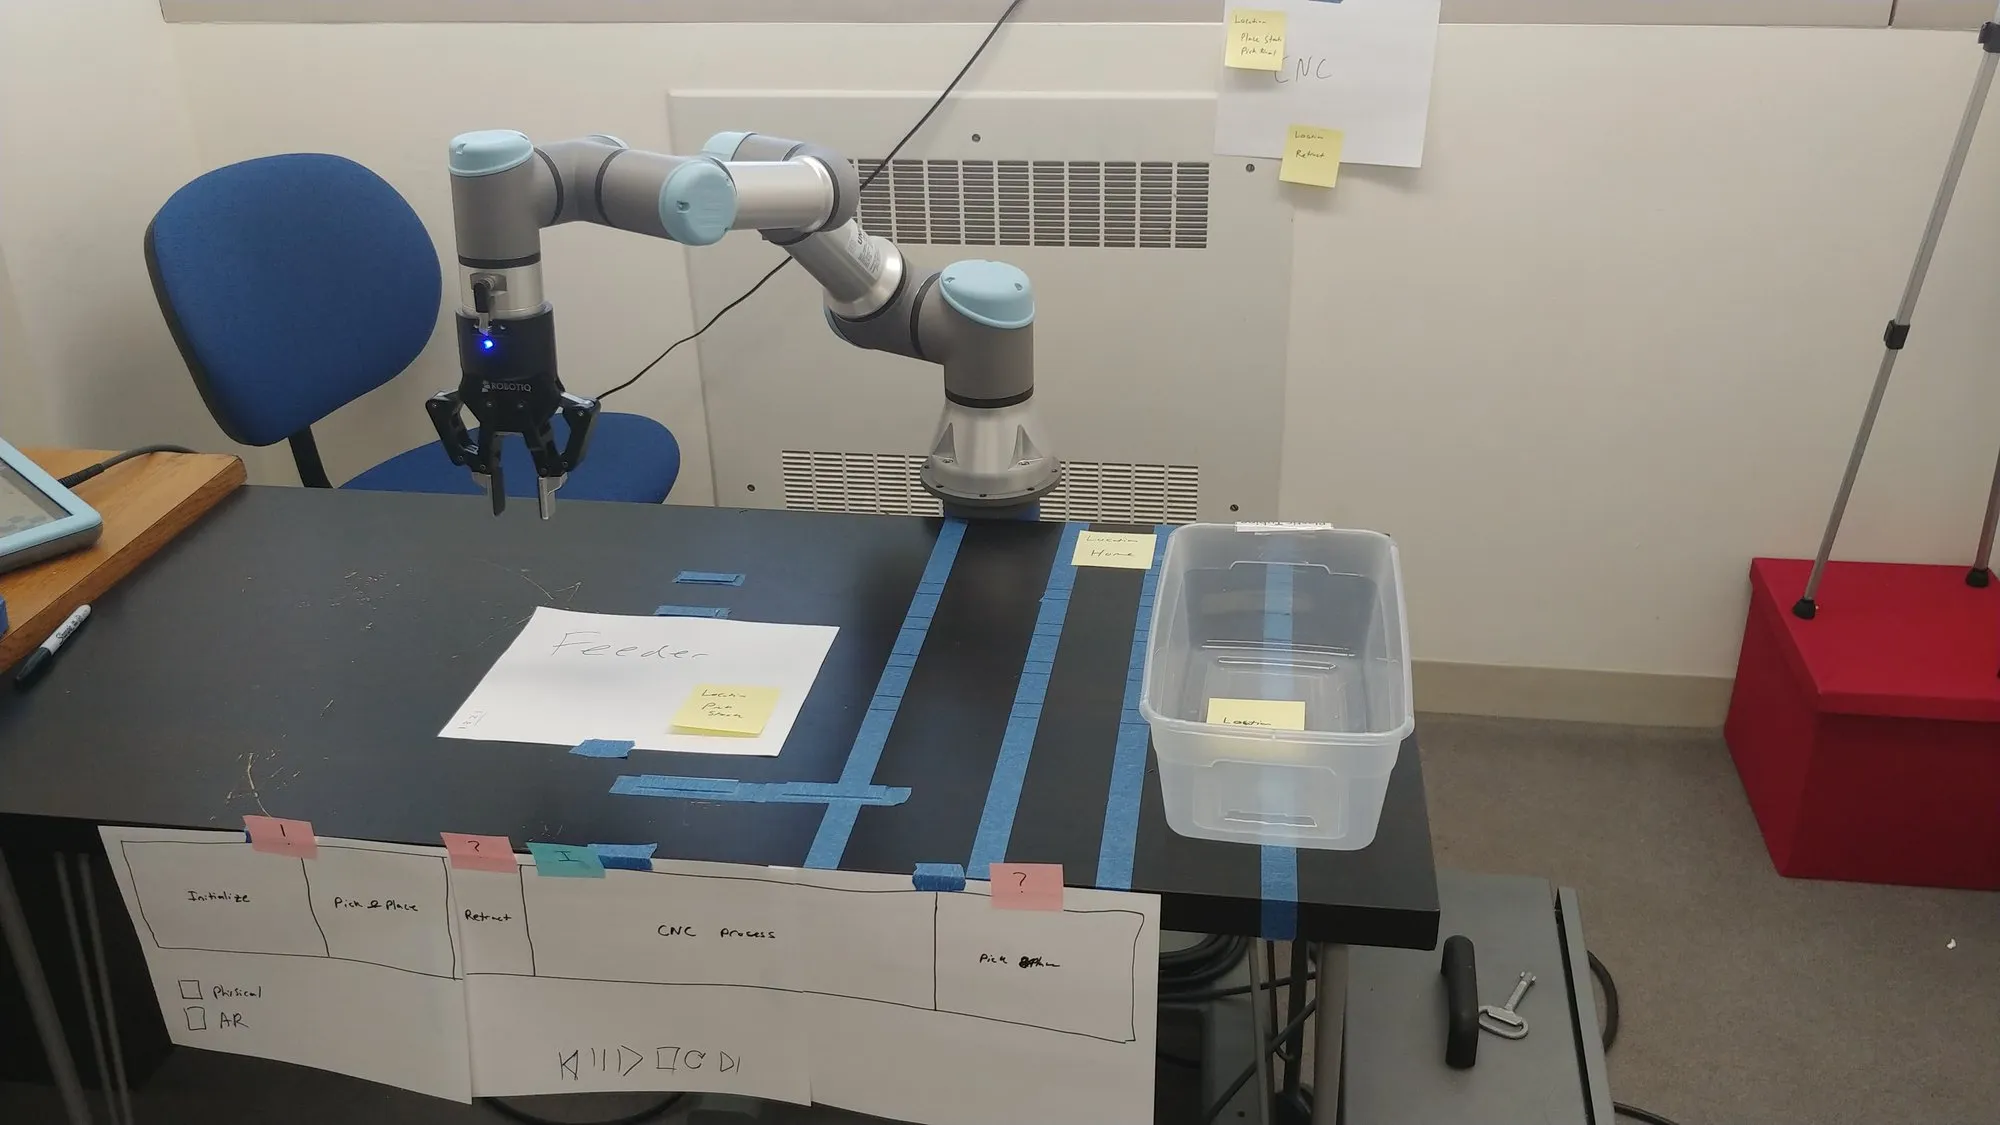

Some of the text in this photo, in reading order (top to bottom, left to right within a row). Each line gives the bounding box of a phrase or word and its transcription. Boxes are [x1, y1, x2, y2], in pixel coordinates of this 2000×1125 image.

[551, 631, 709, 659] Feeder
[188, 891, 250, 902] Initialize
[334, 896, 363, 909] Pick
[386, 900, 419, 911] Place
[465, 909, 512, 922] Retract
[657, 925, 697, 937] CNC
[979, 953, 1008, 964] Pick
[220, 1011, 250, 1030] AR
